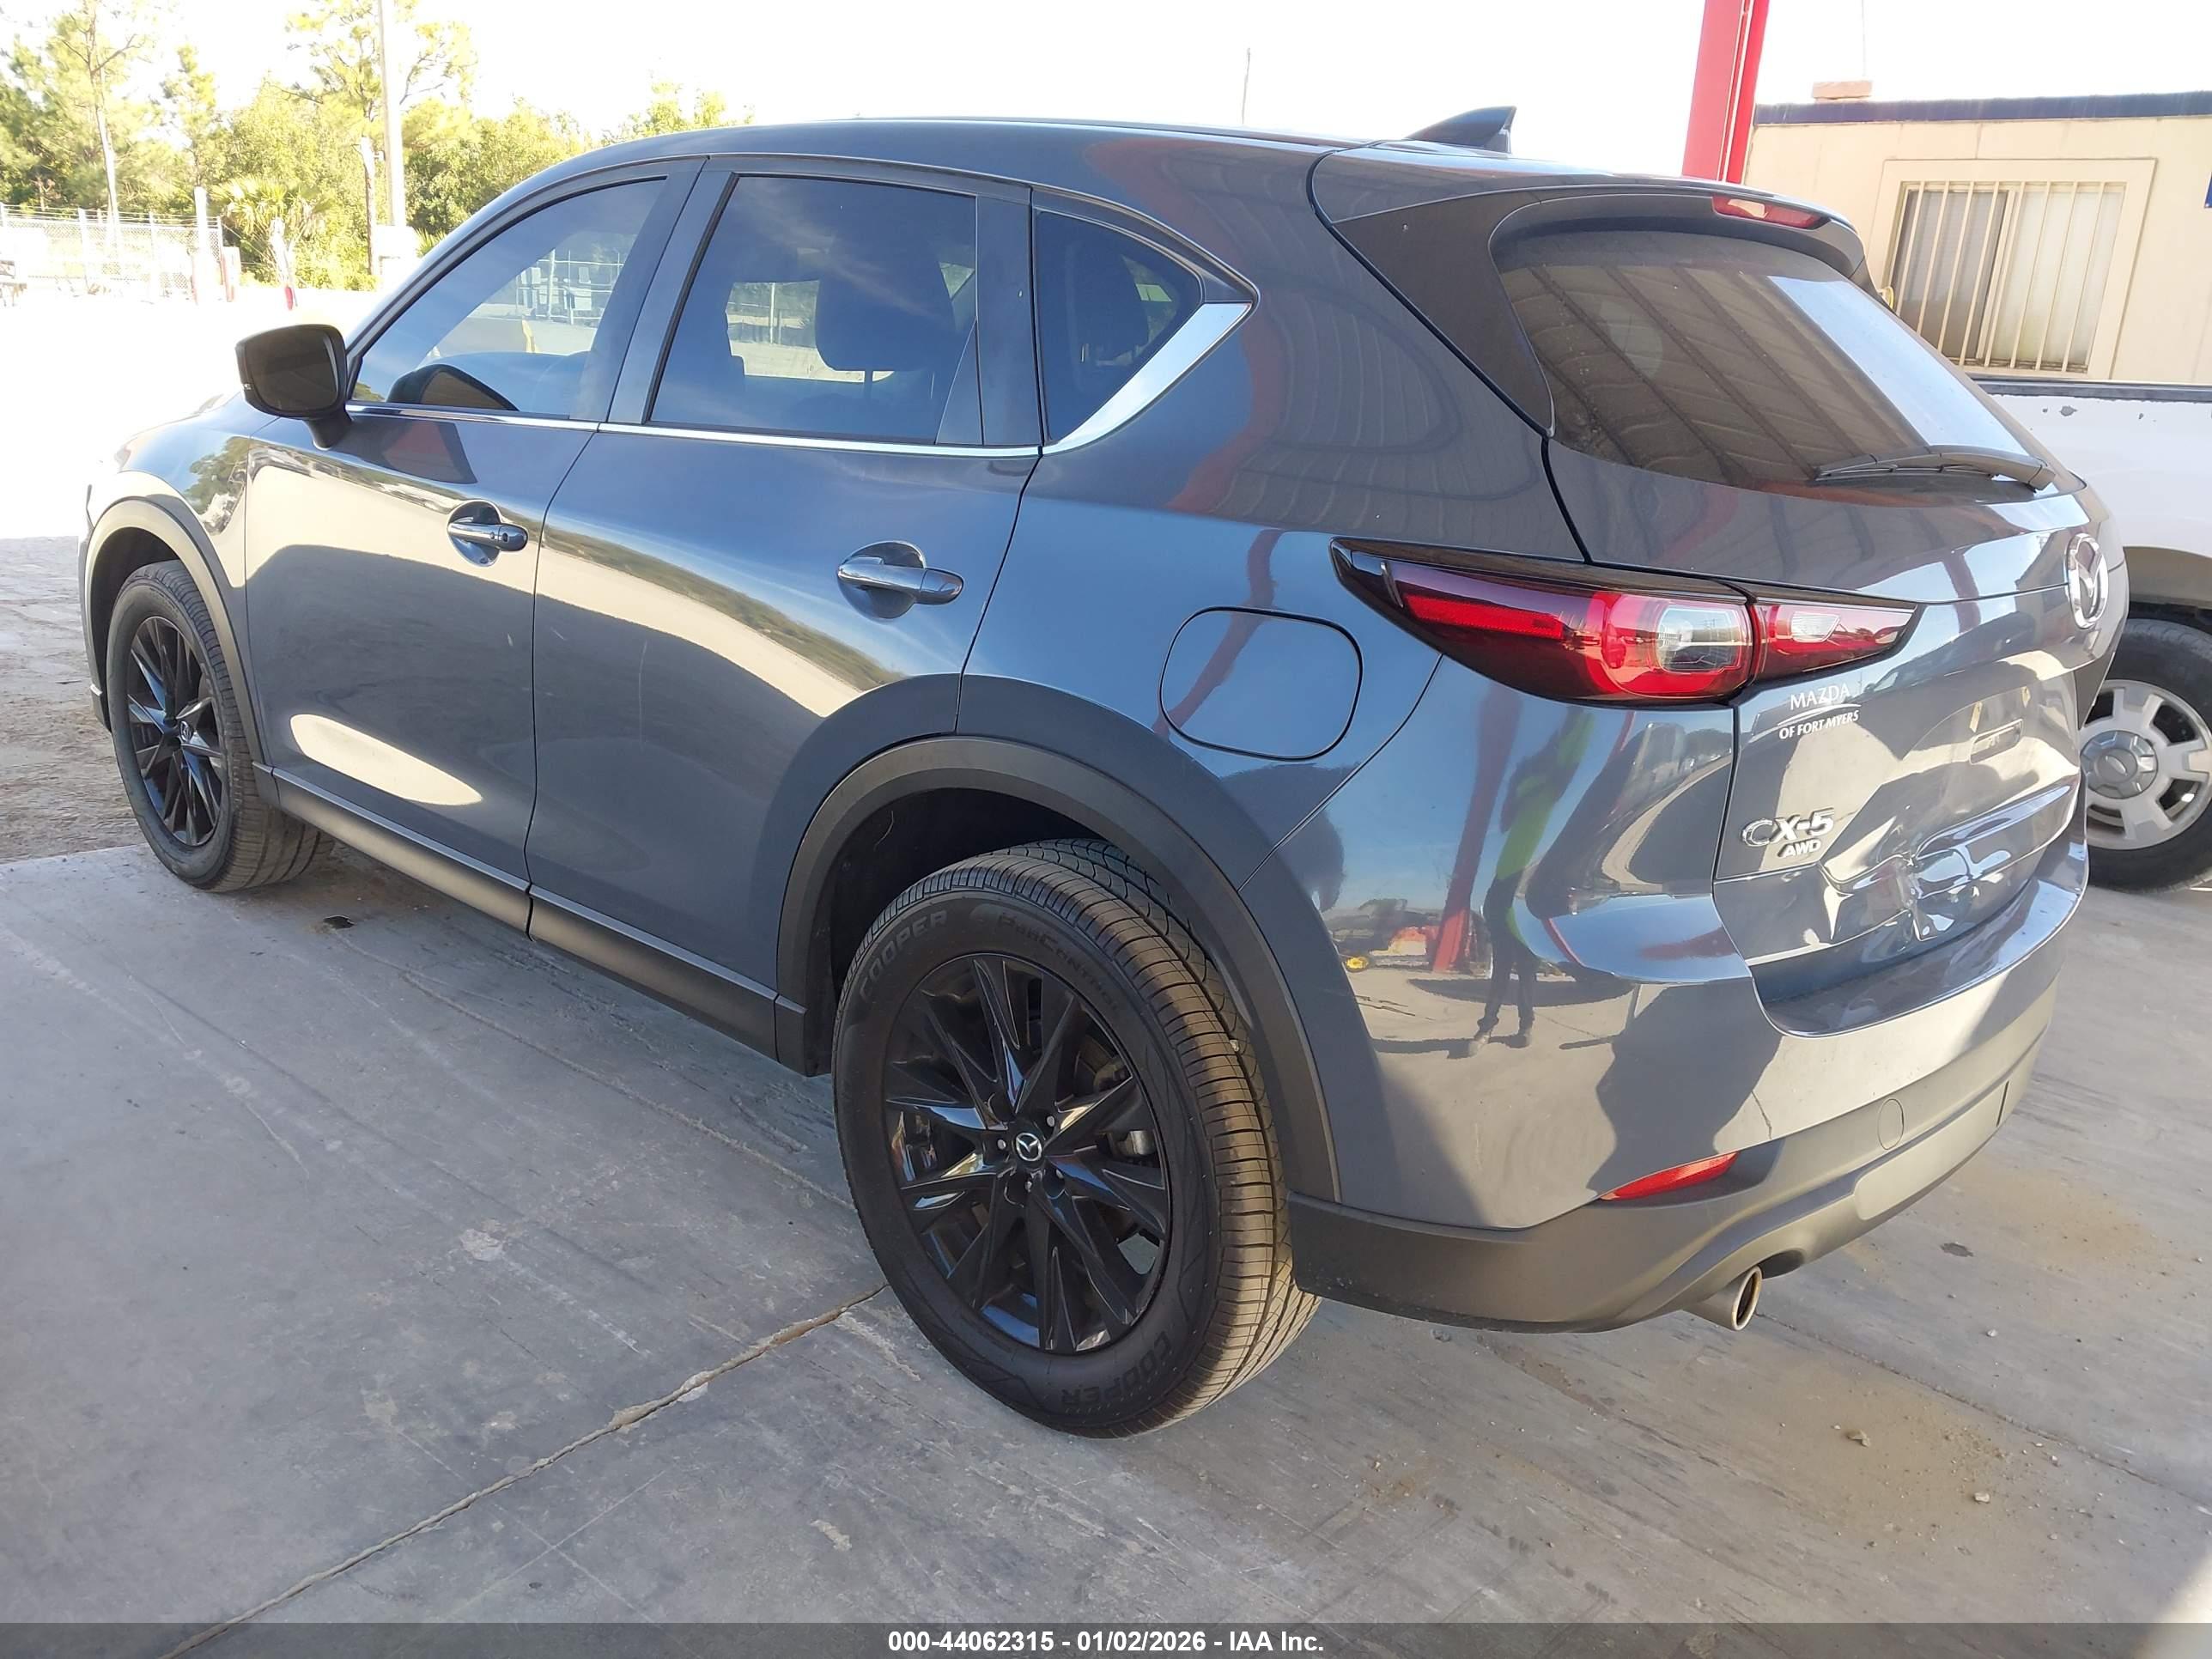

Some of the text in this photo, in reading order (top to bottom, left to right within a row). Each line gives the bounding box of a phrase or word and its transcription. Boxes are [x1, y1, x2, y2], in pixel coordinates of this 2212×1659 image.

[1790, 684, 1850, 711] MAZDA
[1778, 710, 1860, 740] OF FORT MYERS
[1741, 807, 1835, 847] CX-5
[1778, 838, 1821, 858] AWD
[859, 908, 948, 1003] COOPER
